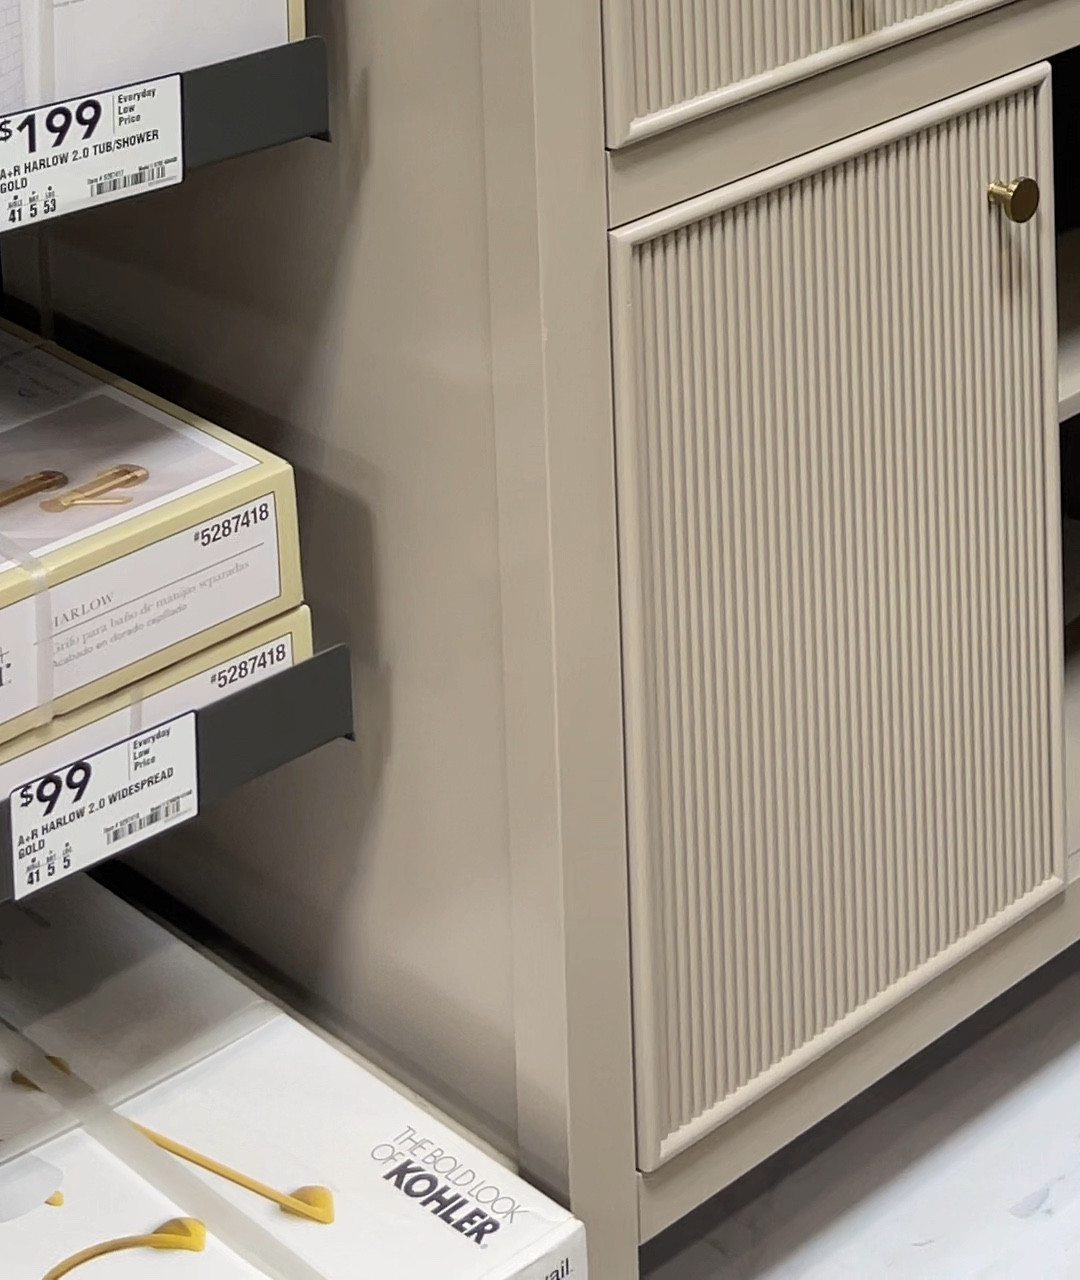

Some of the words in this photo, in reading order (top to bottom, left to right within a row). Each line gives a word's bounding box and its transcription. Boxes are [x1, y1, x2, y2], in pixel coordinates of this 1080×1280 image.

[118, 88, 156, 104] Everyday
[118, 104, 136, 115] Low
[118, 114, 141, 126] Price
[0, 99, 102, 154] $199
[24, 152, 69, 173] HARLOW
[72, 147, 89, 162] 2.0
[93, 129, 159, 156] TUB/SHOWER
[0, 177, 28, 193] GOLD
[8, 208, 22, 223] 41
[29, 203, 38, 218] 5
[43, 198, 57, 214] 53
[193, 502, 270, 547] #5287418
[211, 643, 287, 689] #5287418
[133, 727, 171, 750] Everyday
[133, 748, 150, 761] Low
[134, 755, 156, 771] Price
[20, 760, 92, 817] $99
[41, 806, 86, 834] HARLOW
[88, 799, 106, 815] 2.0
[108, 766, 174, 805] WIDESPREAD
[18, 839, 45, 860] GOLD
[26, 869, 40, 885] 41
[47, 862, 55, 876] 5
[63, 855, 71, 869] 5
[370, 1143, 405, 1165] OF
[393, 1125, 433, 1157] THE
[422, 1147, 476, 1187] BOLD
[467, 1180, 529, 1224] LOOK
[383, 1158, 500, 1245] KOHLER
